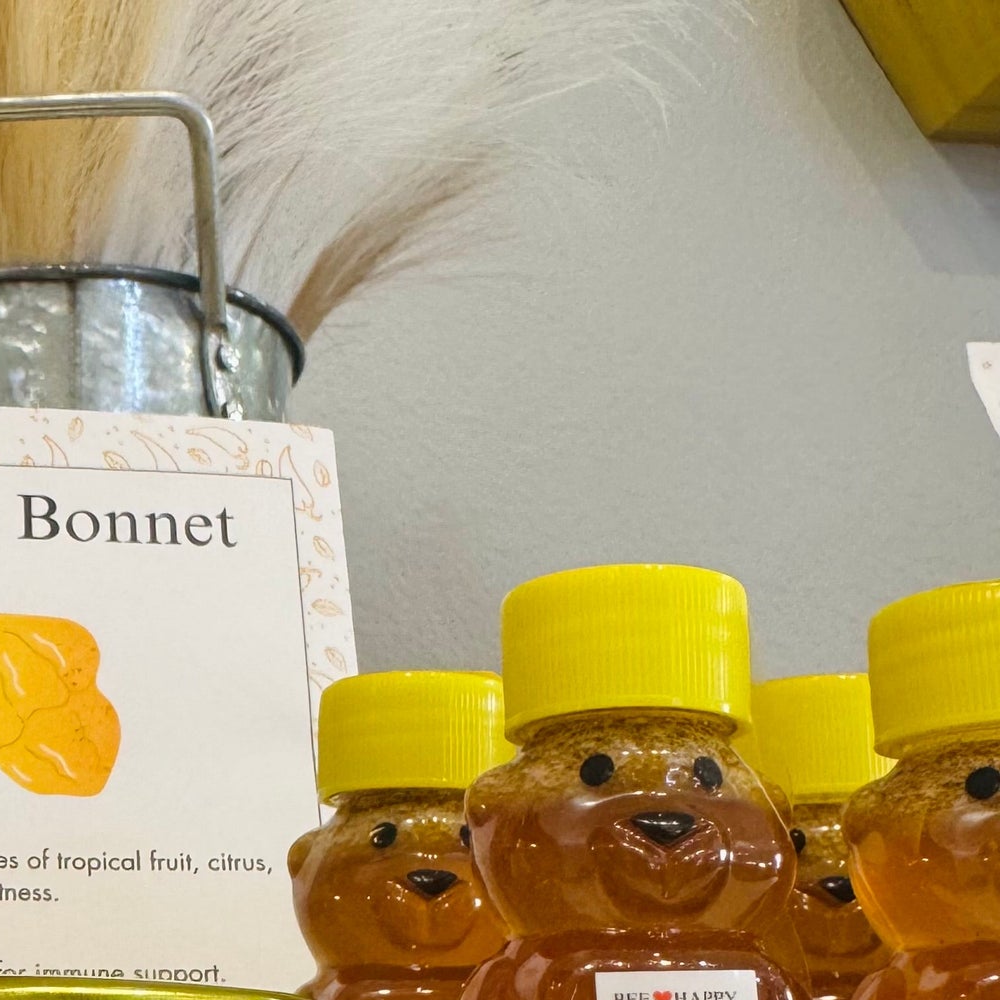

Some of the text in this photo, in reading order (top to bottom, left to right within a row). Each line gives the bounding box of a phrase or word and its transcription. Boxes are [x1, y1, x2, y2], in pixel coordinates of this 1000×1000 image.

[17, 493, 238, 549] Bonnet
[27, 848, 50, 870] of
[58, 850, 141, 877] tropical
[150, 850, 199, 875] fruit,
[208, 853, 273, 875] citrus,
